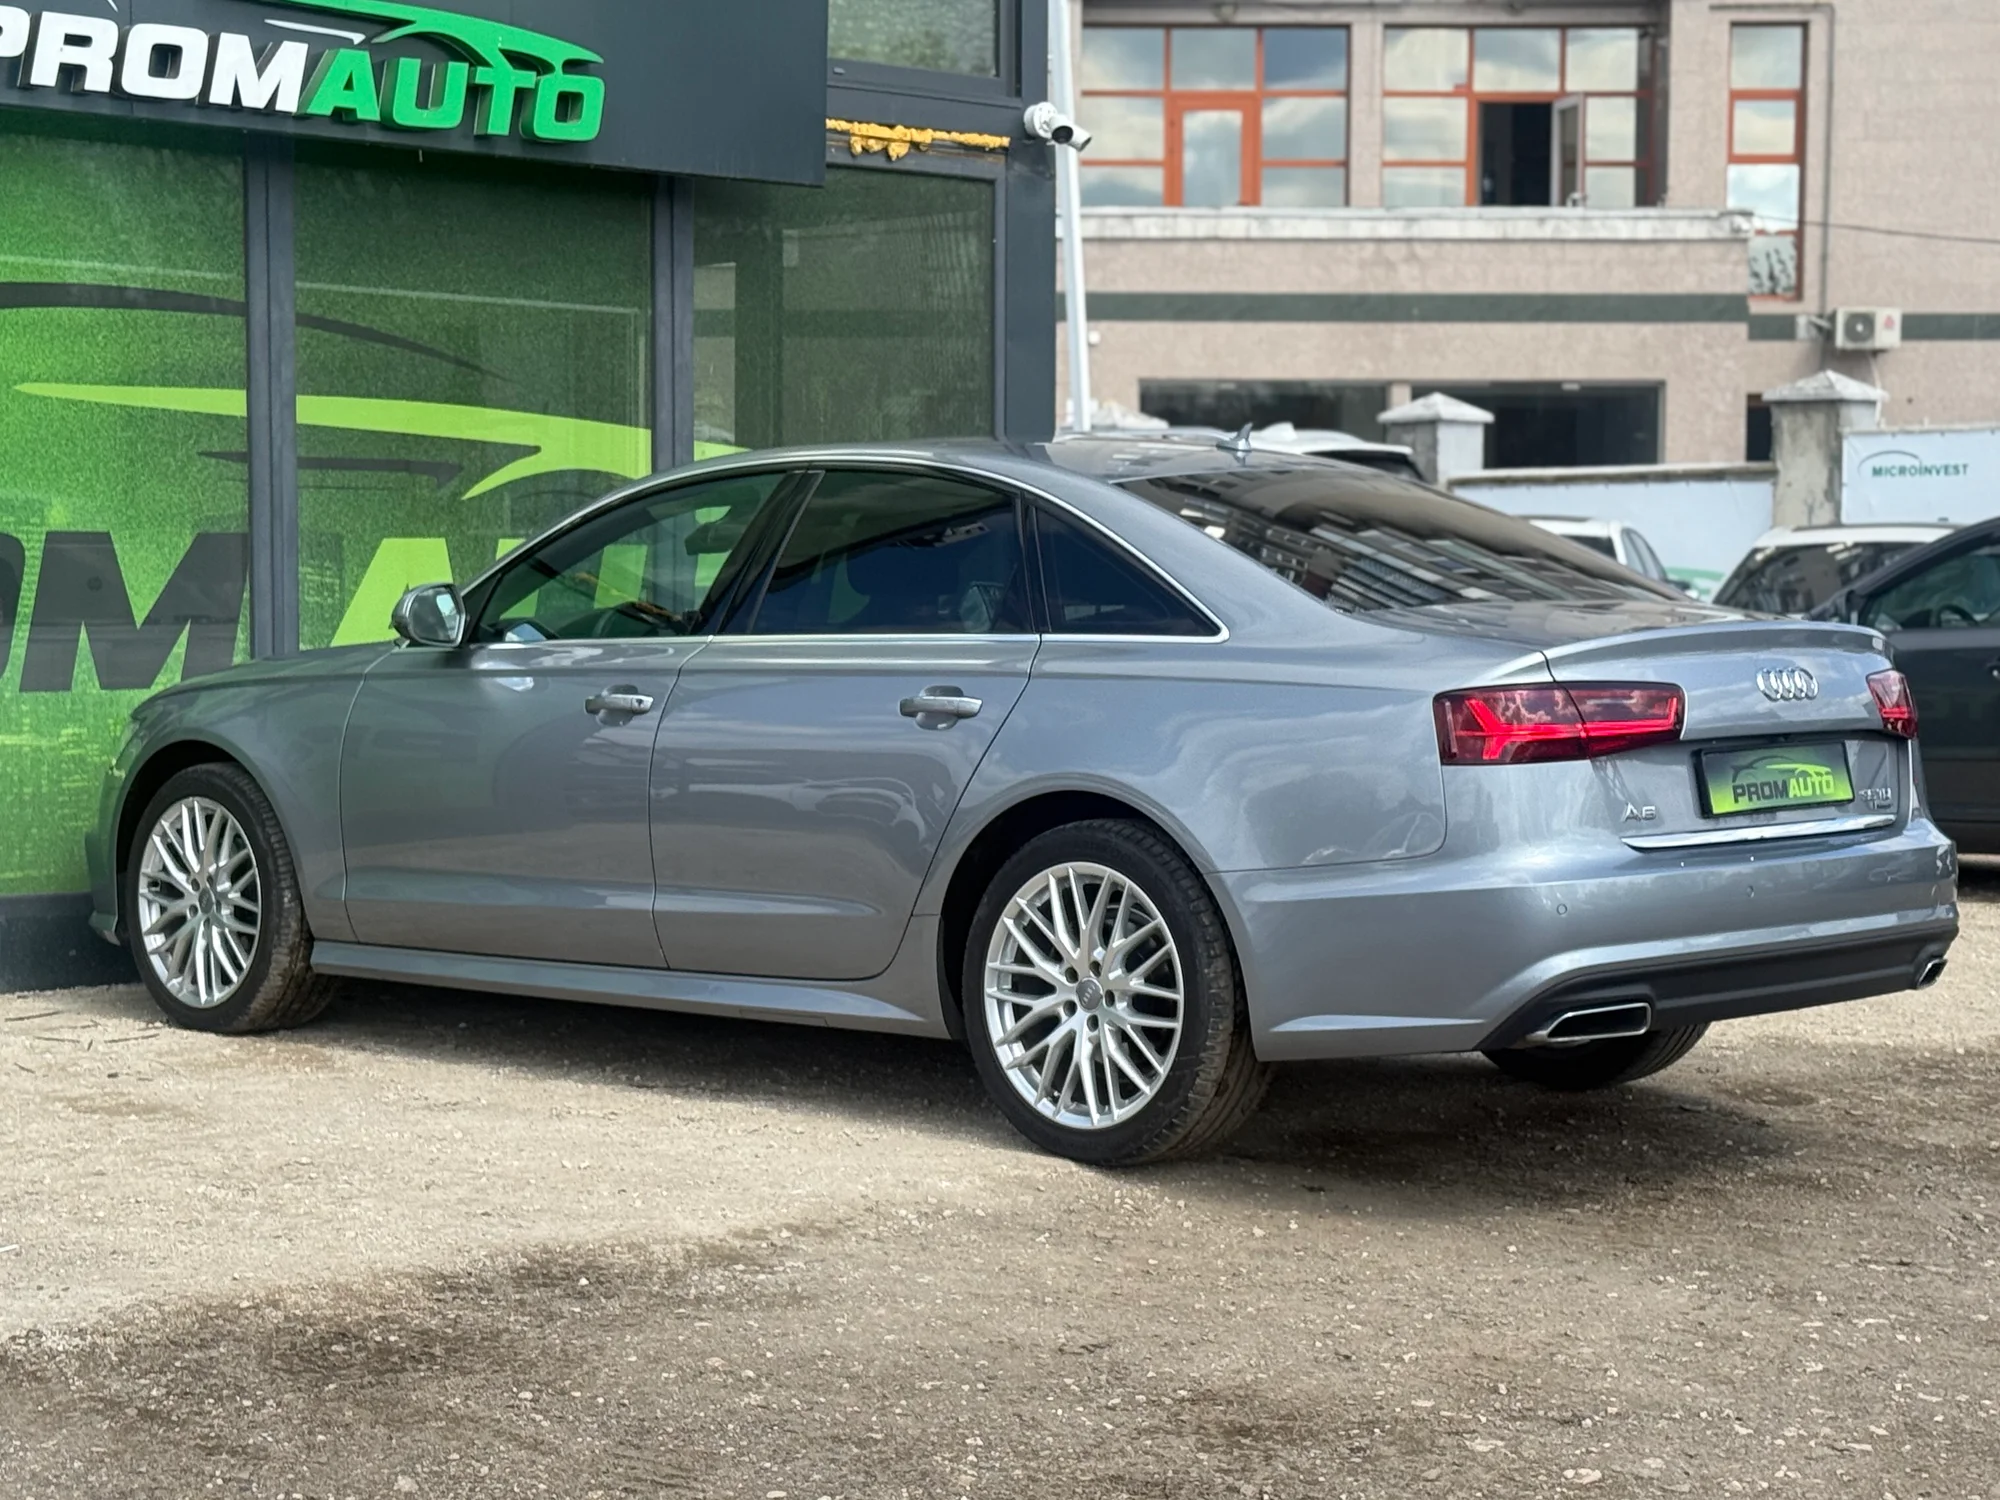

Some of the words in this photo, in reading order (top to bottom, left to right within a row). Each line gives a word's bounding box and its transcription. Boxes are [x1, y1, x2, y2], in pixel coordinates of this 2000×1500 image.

[1872, 463, 1968, 477] MICROINVEST
[1732, 776, 1835, 804] PROMAUTO
[1621, 802, 1656, 821] A6
